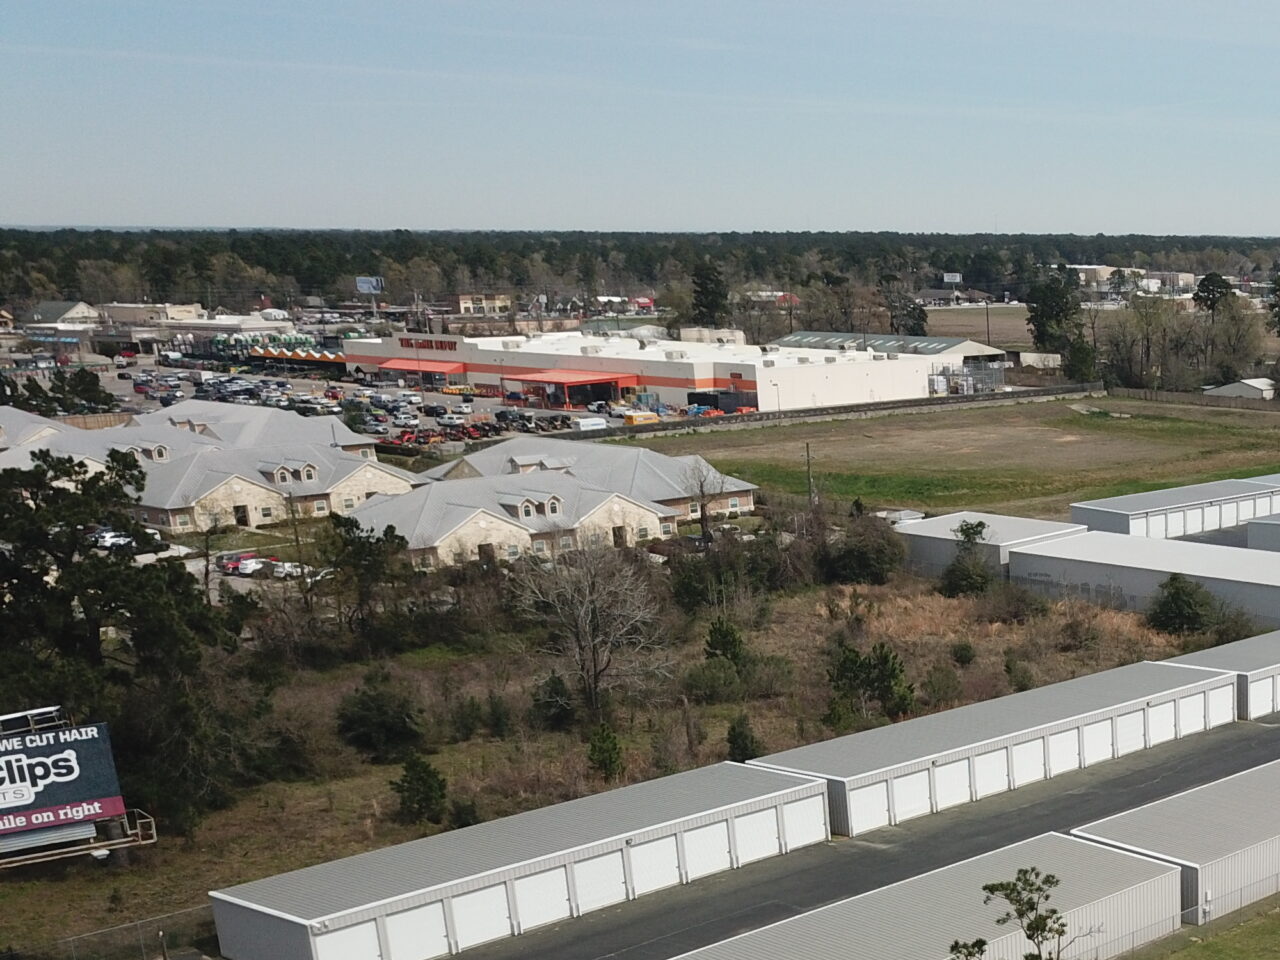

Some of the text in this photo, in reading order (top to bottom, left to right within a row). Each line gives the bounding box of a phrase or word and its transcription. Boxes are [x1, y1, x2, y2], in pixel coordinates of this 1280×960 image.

[25, 733, 56, 748] CUT
[59, 727, 99, 743] HAIR
[31, 811, 55, 824] on
[59, 801, 103, 820] right
